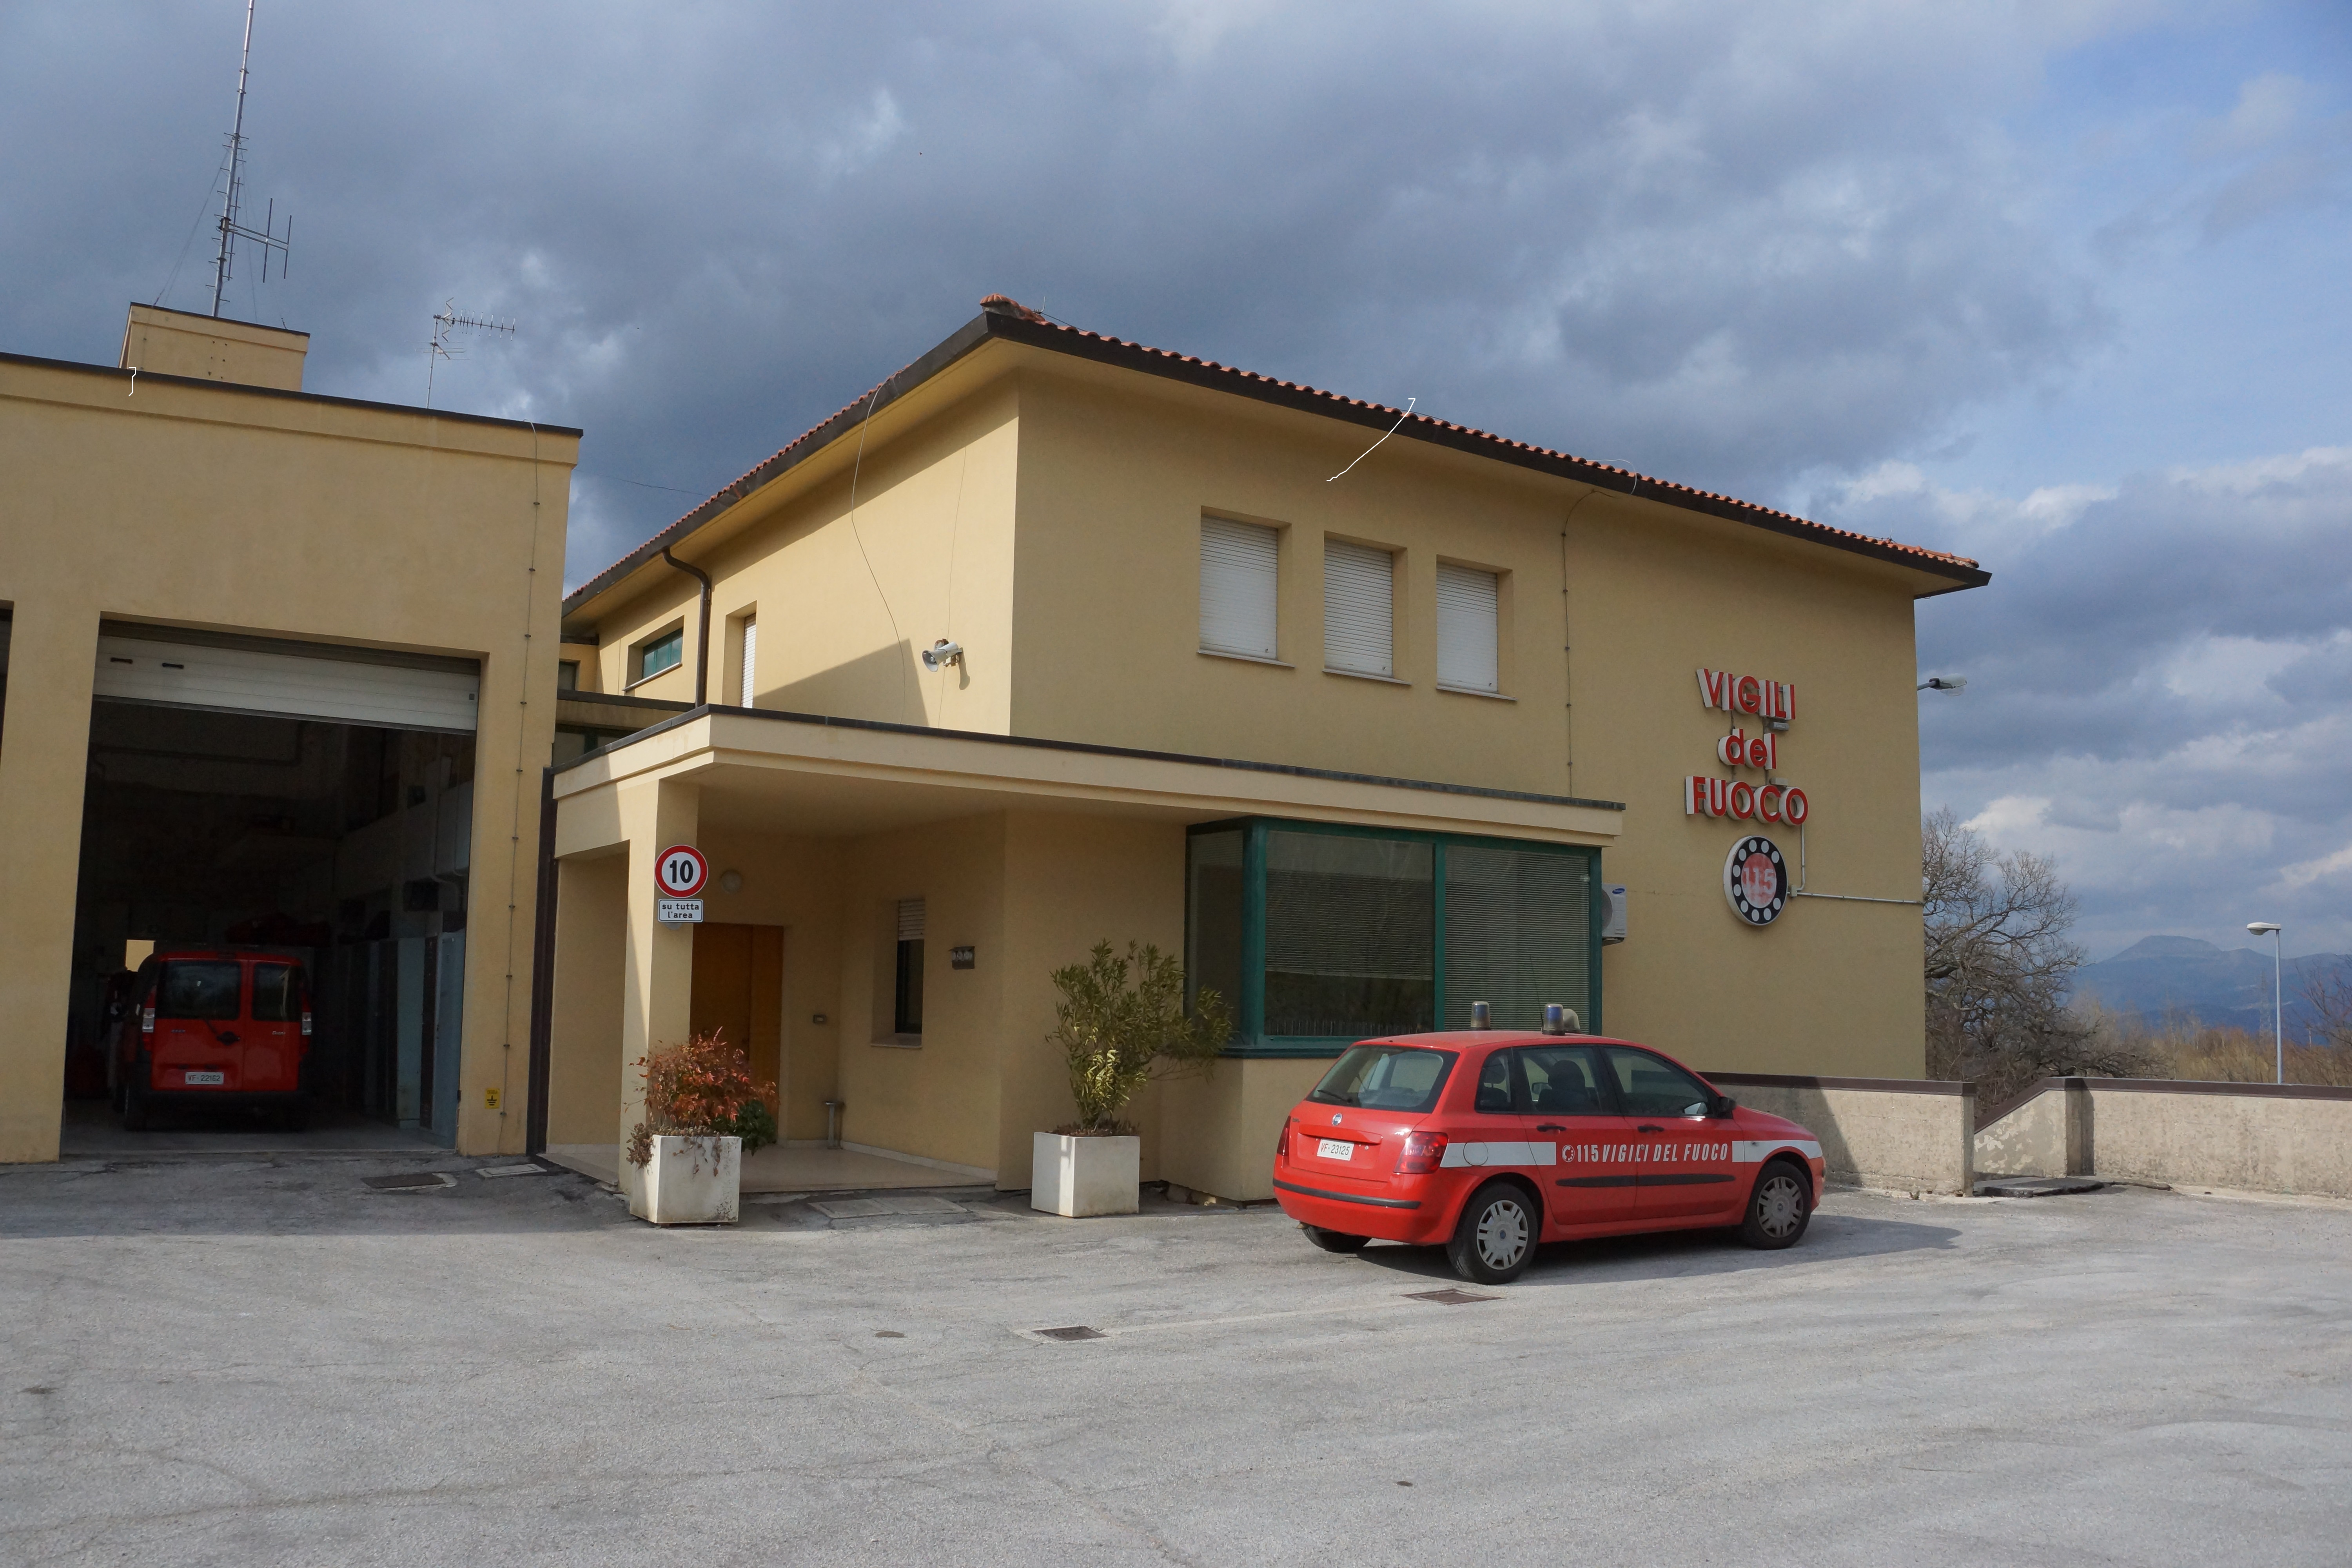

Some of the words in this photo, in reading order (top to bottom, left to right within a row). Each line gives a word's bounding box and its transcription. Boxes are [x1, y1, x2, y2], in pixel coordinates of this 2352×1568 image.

[1697, 668, 1796, 720] VIGILI
[1718, 728, 1777, 769] del
[1686, 775, 1809, 825] FUOCO
[669, 860, 694, 884] 10
[1743, 867, 1775, 894] 115
[1321, 1143, 1328, 1152] VF
[1330, 1144, 1350, 1155] 23125
[1577, 1144, 1599, 1162] 115
[1602, 1144, 1649, 1162] VIGILI
[1653, 1144, 1677, 1161] DEL
[1683, 1143, 1728, 1161] FUOCO
